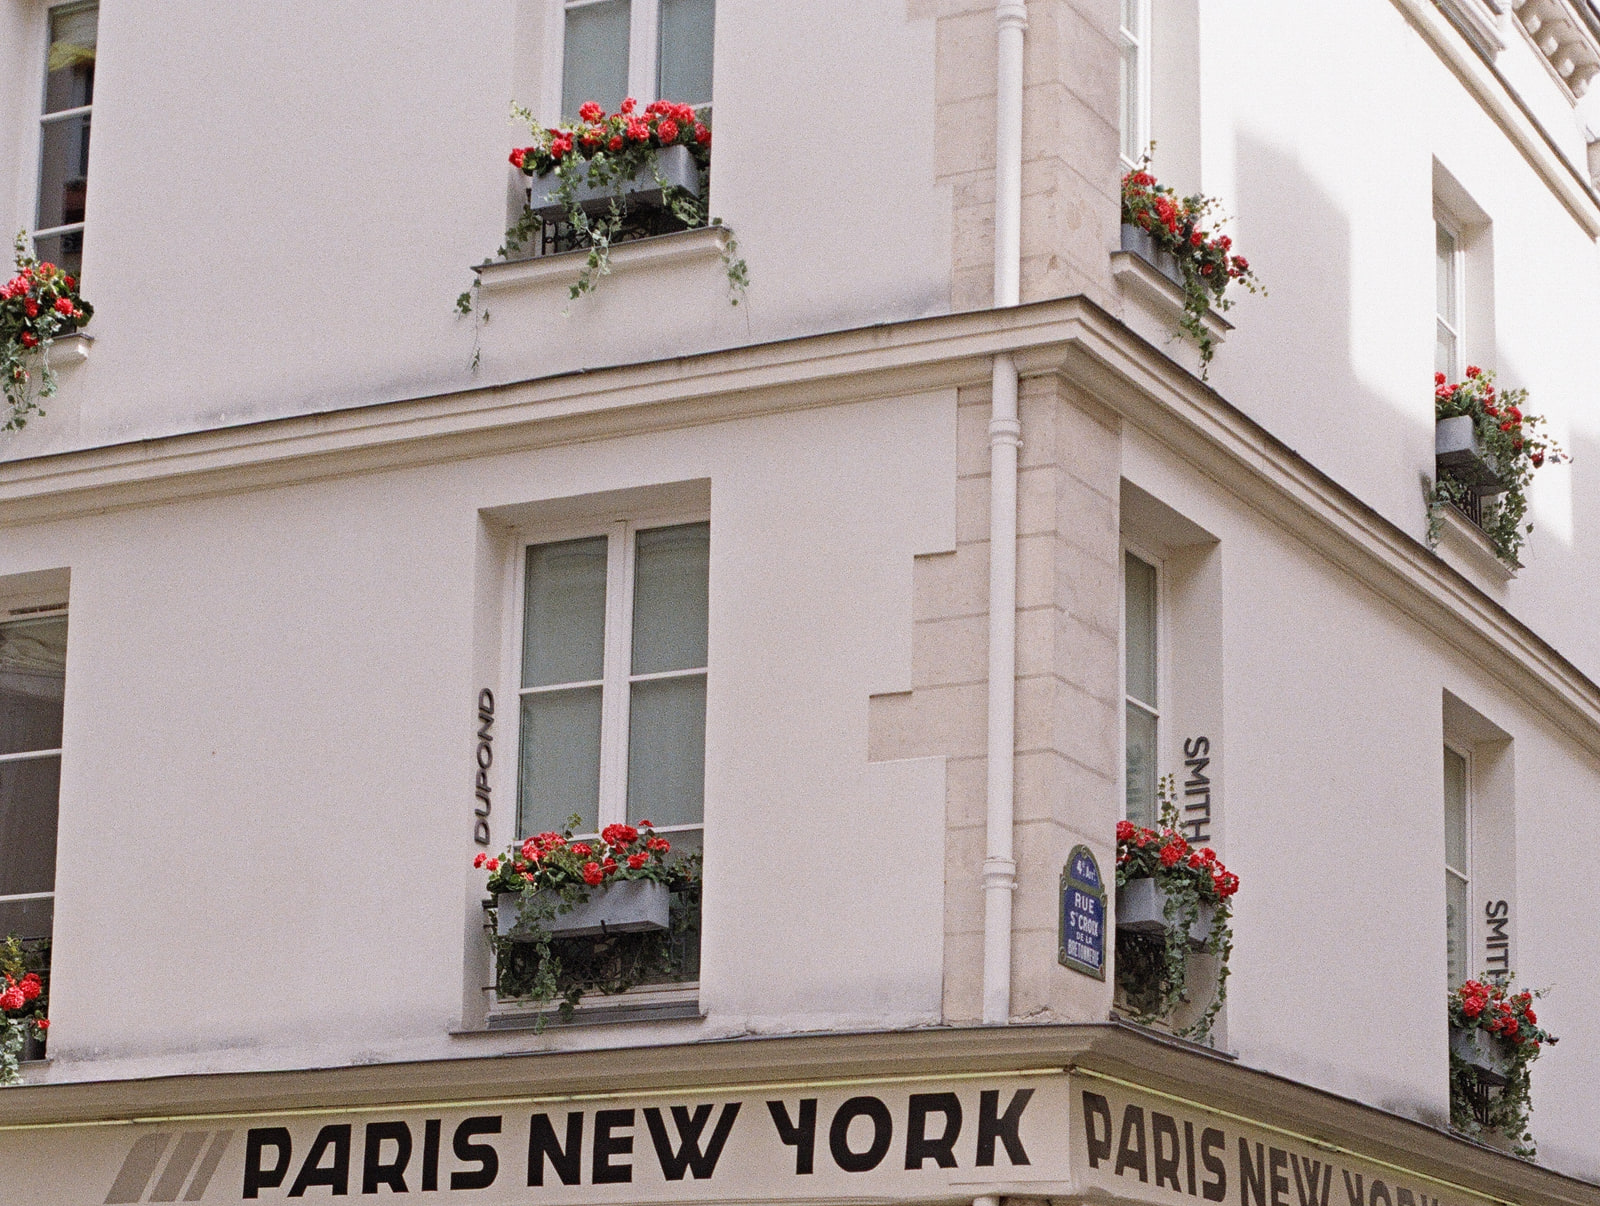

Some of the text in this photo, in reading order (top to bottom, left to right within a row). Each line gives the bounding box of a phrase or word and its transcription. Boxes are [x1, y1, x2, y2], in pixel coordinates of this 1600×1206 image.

[474, 687, 495, 846] DUPOND
[1183, 736, 1211, 843] SMITH
[1074, 892, 1095, 915] RUE
[1076, 931, 1094, 946] DE LA
[1078, 914, 1099, 938] CROIX
[242, 1088, 1036, 1199] PARIS NEW YORK
[1082, 1090, 1227, 1203] PARIS
